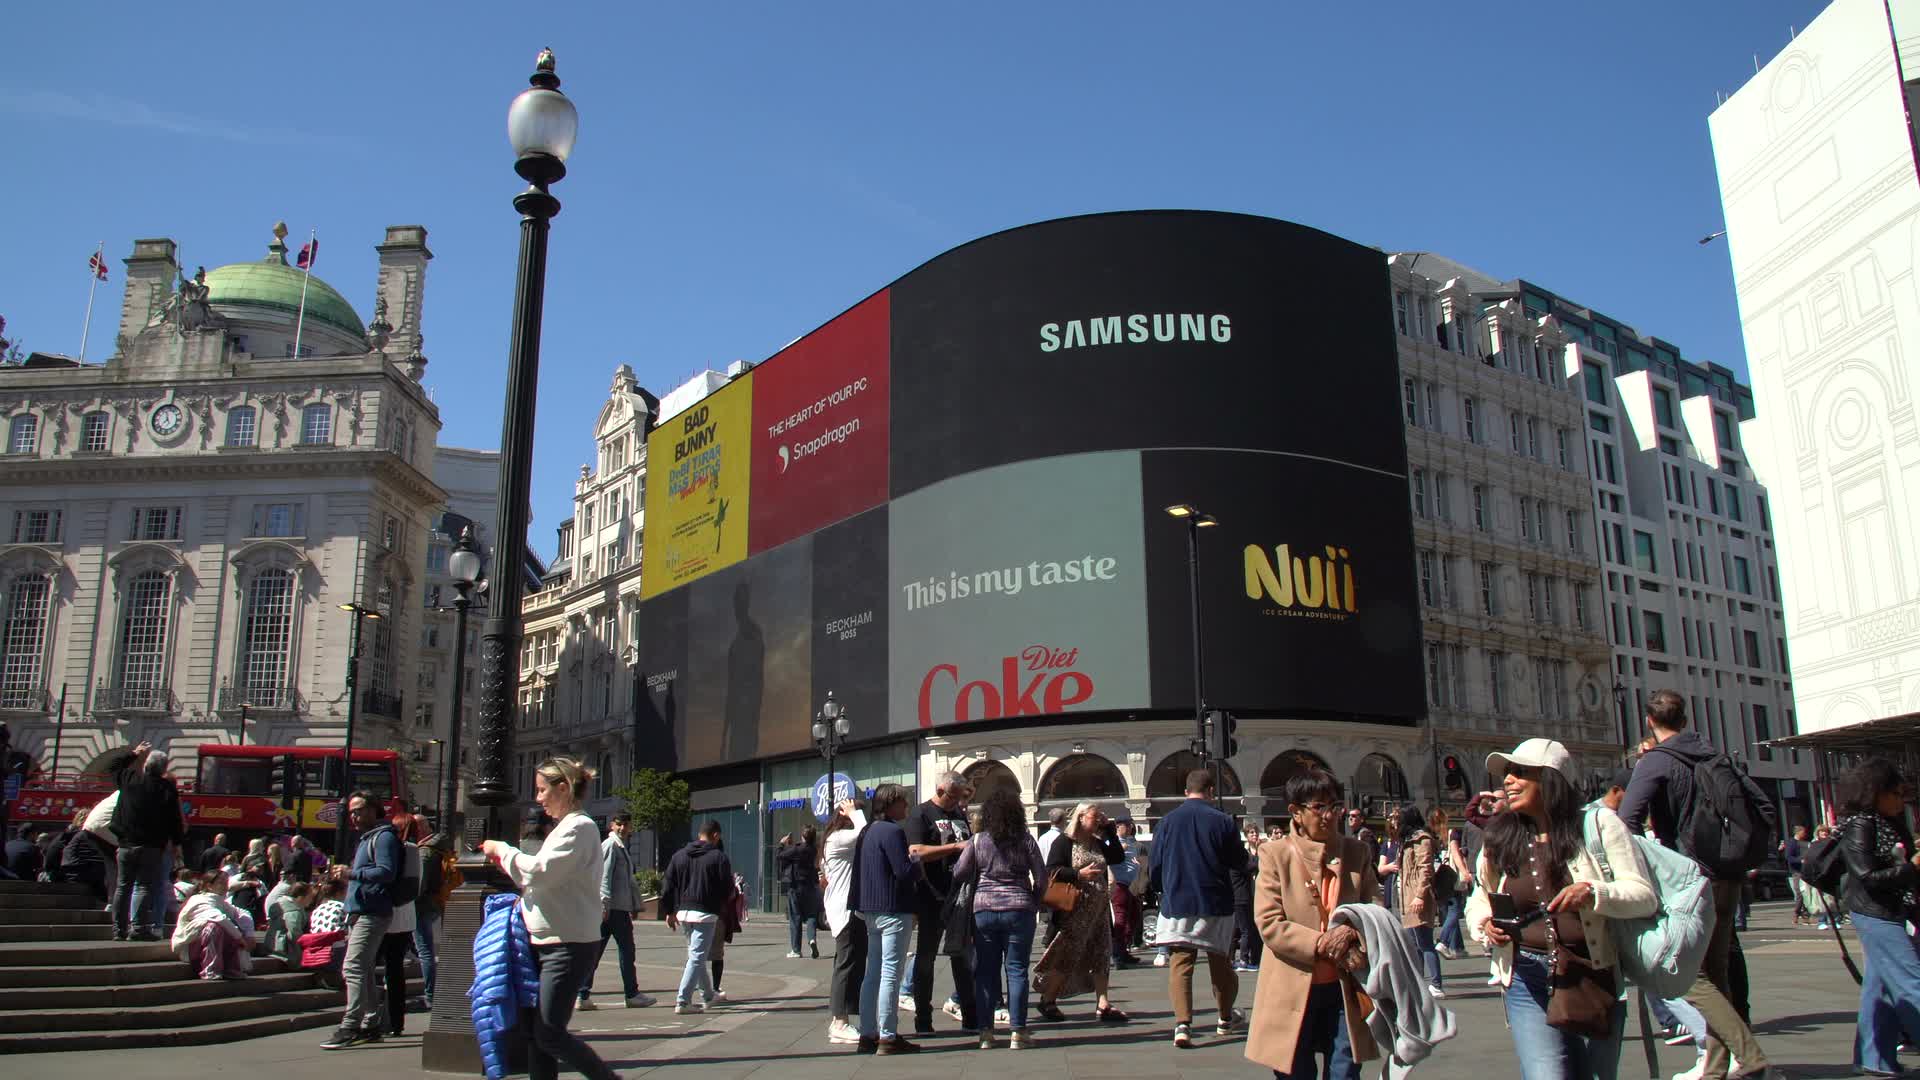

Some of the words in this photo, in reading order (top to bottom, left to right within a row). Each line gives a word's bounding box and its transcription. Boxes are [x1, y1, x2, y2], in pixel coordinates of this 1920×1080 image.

[1040, 313, 1232, 352] SAMSUNG
[684, 405, 709, 435] BAD
[768, 420, 785, 439] THE
[785, 405, 813, 431] HEART
[814, 398, 827, 414] OF
[828, 384, 852, 407] YOUR
[853, 377, 867, 395] PC
[675, 422, 717, 463] BUNNY
[793, 418, 860, 460] Snapdragon
[903, 576, 947, 611] This
[950, 570, 971, 600] is
[974, 567, 1023, 595] my
[1028, 552, 1117, 586] taste
[1244, 543, 1356, 613] Nuii
[826, 610, 873, 635] BECKHAM
[1262, 608, 1276, 616] ICE
[1277, 609, 1303, 618] CREAM
[840, 629, 857, 641] BOSS
[1022, 644, 1079, 671] Diet
[647, 668, 678, 688] BECKHAM
[918, 656, 1094, 729] Coke
[768, 798, 806, 814] pharmacy
[815, 780, 849, 817] Bots
